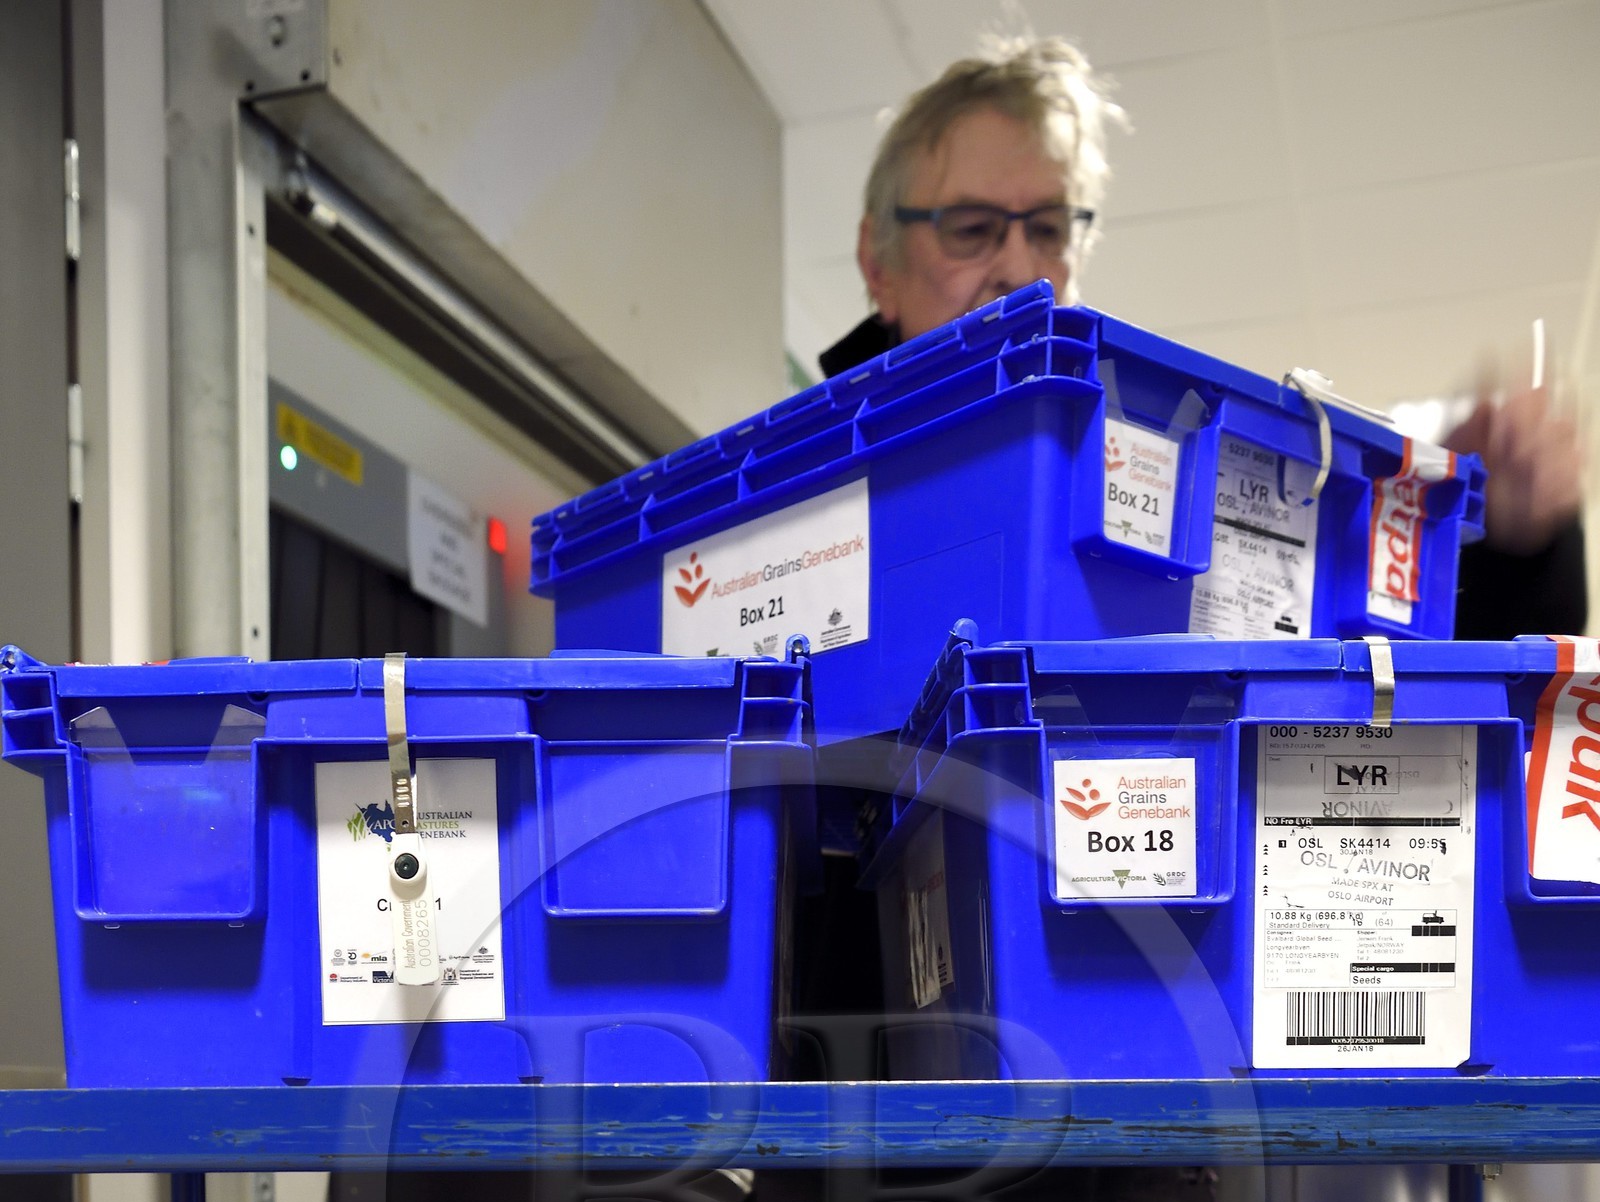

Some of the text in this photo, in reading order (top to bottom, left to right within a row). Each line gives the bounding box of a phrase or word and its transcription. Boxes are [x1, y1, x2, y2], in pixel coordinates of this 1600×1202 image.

[1130, 456, 1160, 475] Grains
[1240, 479, 1269, 503] LYR
[1108, 482, 1160, 516] Box 21
[740, 596, 785, 627] Box 21
[1270, 726, 1298, 738] 000
[1313, 726, 1350, 738] 5237
[1356, 726, 1393, 738] 9530
[1337, 765, 1388, 786] LYR
[1117, 776, 1186, 789] Australian
[1118, 791, 1167, 804] Grains
[417, 811, 473, 820] USTRALIAN
[1118, 806, 1190, 819] Genebank
[416, 821, 459, 829] ASTURES
[420, 830, 466, 838] ENEBANK
[1088, 830, 1174, 853] Box 18
[1298, 838, 1323, 848] OSL
[1340, 838, 1390, 848] SK4414
[1300, 850, 1431, 882] OSL AVINOR
[1362, 880, 1379, 890] SPX
[1328, 890, 1394, 906] OSLO AIRPORT
[1300, 912, 1312, 921] Kg
[1375, 918, 1393, 927] (64)
[415, 900, 431, 967] 0008265
[1352, 975, 1381, 984] Seeds
